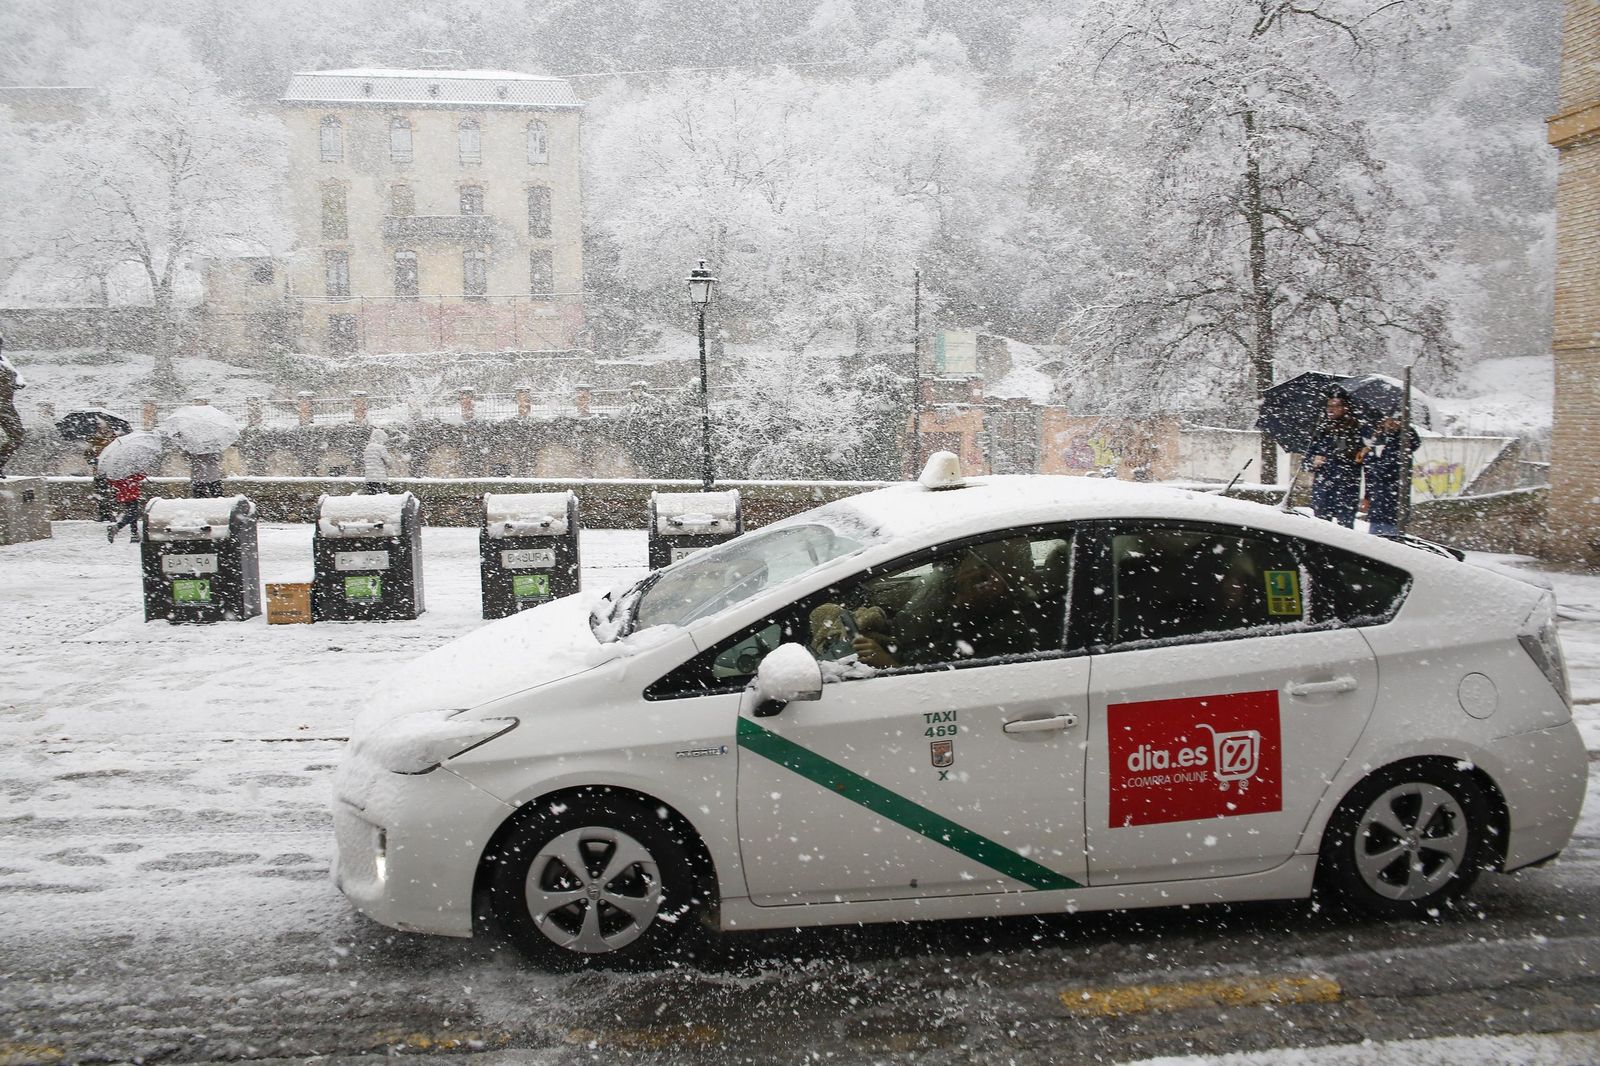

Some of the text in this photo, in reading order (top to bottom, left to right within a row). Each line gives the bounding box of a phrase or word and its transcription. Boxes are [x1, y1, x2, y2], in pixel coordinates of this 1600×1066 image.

[168, 557, 210, 568] BASRA
[923, 710, 957, 724] TAXI
[924, 724, 957, 738] 469
[1127, 744, 1208, 772] dia.es
[938, 769, 949, 781] X
[1127, 770, 1208, 788] COMPRA ONLINE
